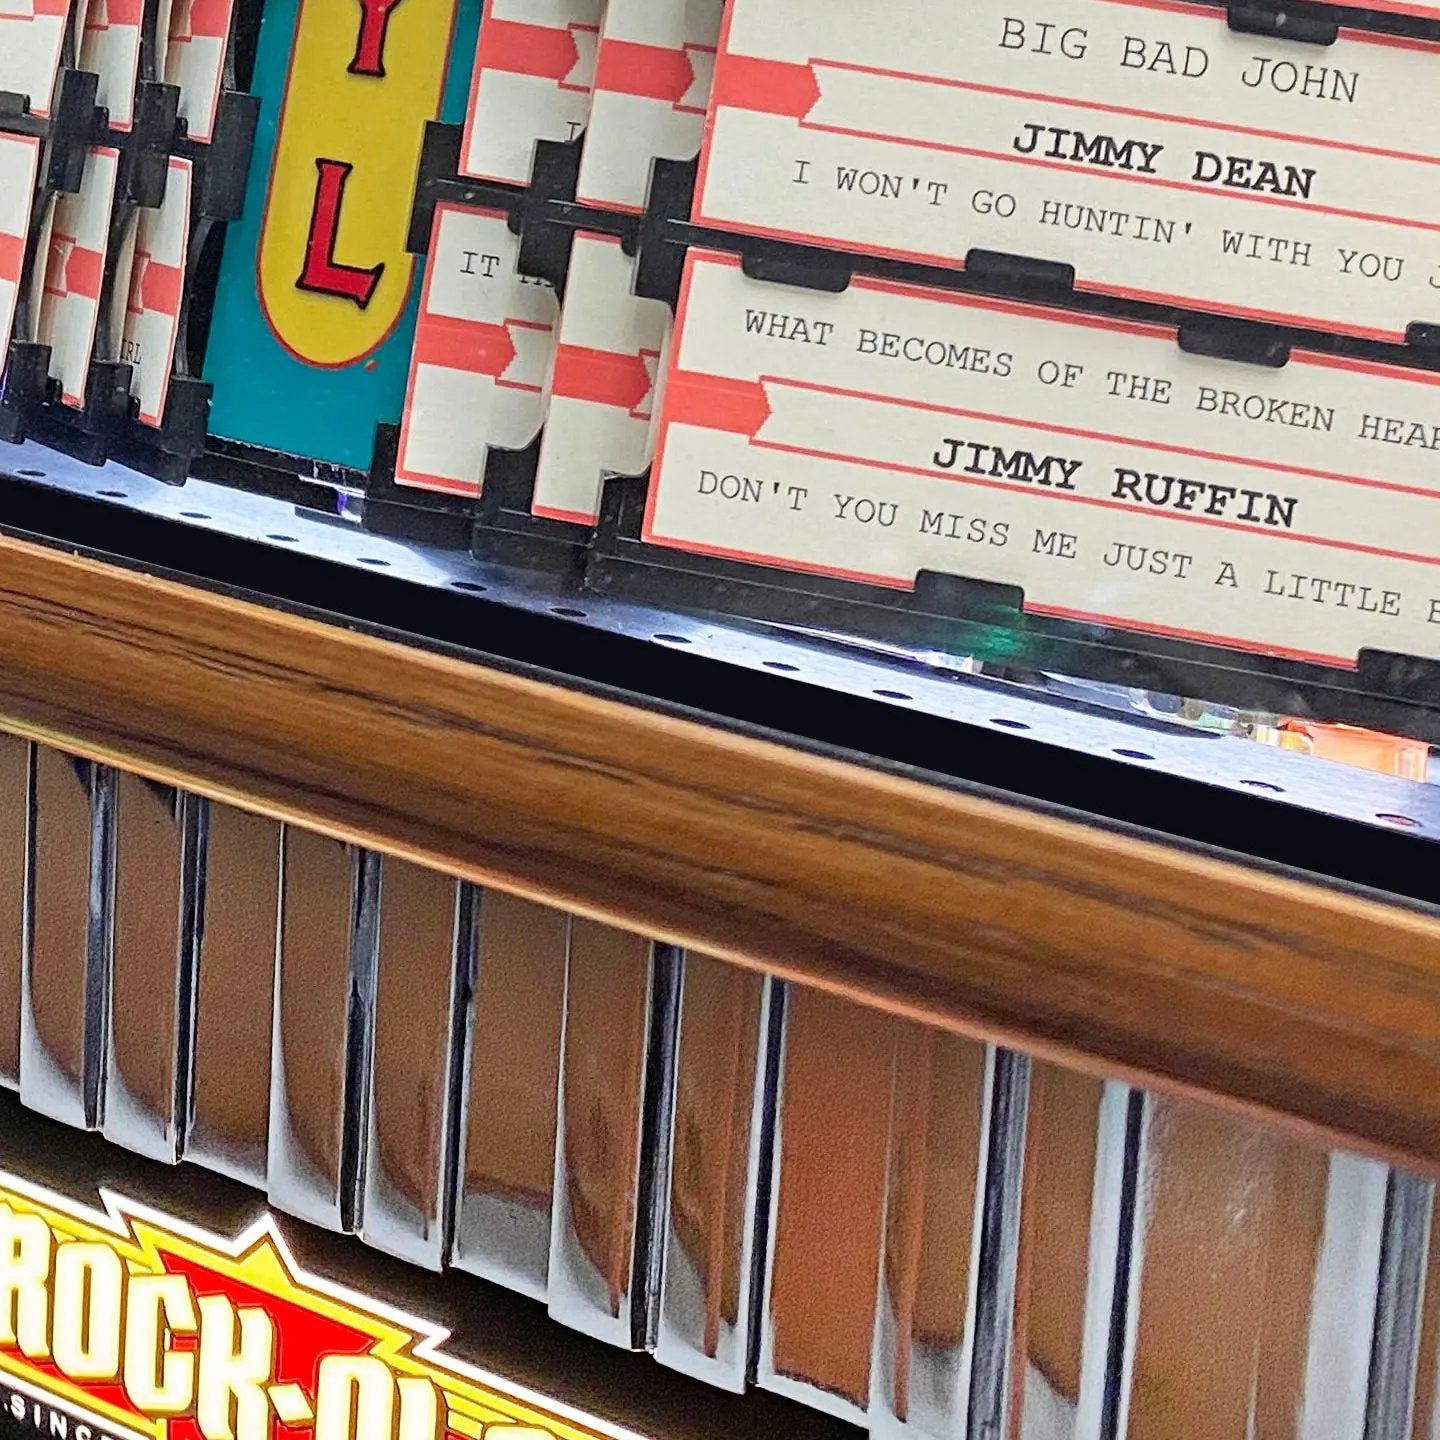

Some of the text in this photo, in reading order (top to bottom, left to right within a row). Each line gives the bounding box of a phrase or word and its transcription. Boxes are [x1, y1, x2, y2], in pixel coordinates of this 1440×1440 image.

[998, 17, 1359, 103] BIG BAD JOHN
[1013, 123, 1317, 200] JIMMY DEAN
[460, 251, 500, 278] IT
[792, 159, 810, 184] I
[836, 166, 948, 206] WON'T
[971, 189, 1017, 218] GO
[1039, 199, 1192, 244] HUNTIN'
[1222, 229, 1312, 267] WITH
[1338, 248, 1405, 282] YOU
[745, 308, 1335, 432] WHAT BECOMES OF THE BROKEN
[932, 438, 1298, 528] JIMMY RUFFIN
[697, 470, 808, 511] DON'T
[833, 493, 899, 528] YOU
[918, 509, 1009, 547] MISS
[1032, 528, 1077, 559] ME
[1103, 542, 1193, 579] JUST
[1215, 561, 1239, 589] A
[1264, 569, 1401, 617] LITTLE
